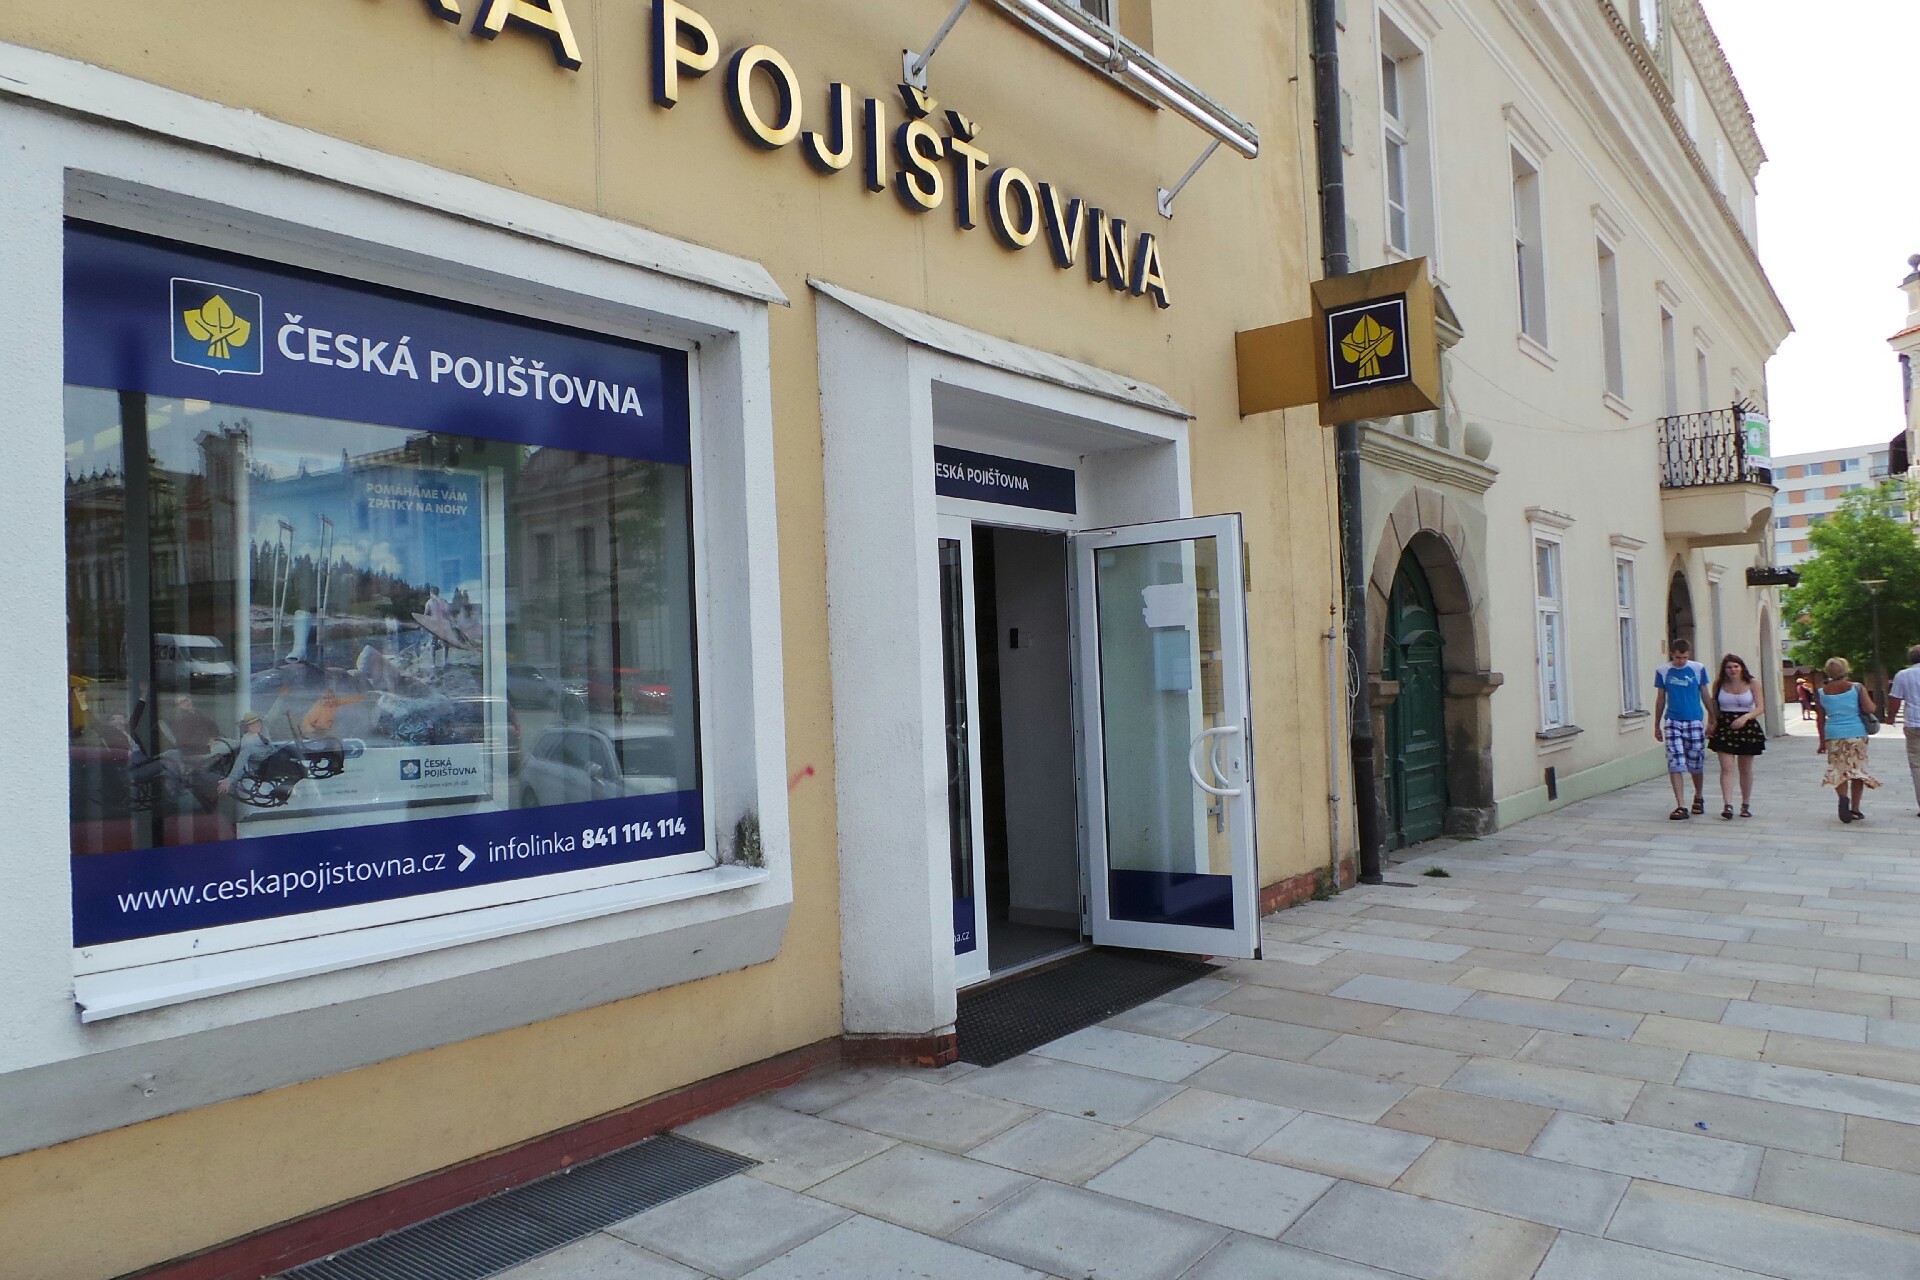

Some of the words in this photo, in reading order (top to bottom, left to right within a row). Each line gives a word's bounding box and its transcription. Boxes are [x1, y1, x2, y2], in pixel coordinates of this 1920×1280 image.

[652, 0, 1171, 309] POJIŠŤOVNA
[277, 312, 419, 380] ČESKÁ
[430, 350, 644, 417] POJIŠŤOVNA
[935, 462, 965, 481] ESKÁ
[966, 467, 1030, 491] POJIŠŤOVNA
[366, 483, 439, 499] POMÁHÁME
[441, 488, 468, 502] VÁM
[367, 497, 414, 511] ZPÁTKY
[416, 502, 433, 513] NA
[435, 504, 468, 516] NOHY
[424, 757, 452, 768] ČESKÁ
[424, 766, 477, 778] POJIŠŤOVNA
[117, 852, 446, 913] www.ceskapojistovna.cz
[488, 832, 575, 863] infolinka
[582, 825, 617, 849] 841
[622, 821, 653, 843] 114
[657, 817, 686, 839] 114
